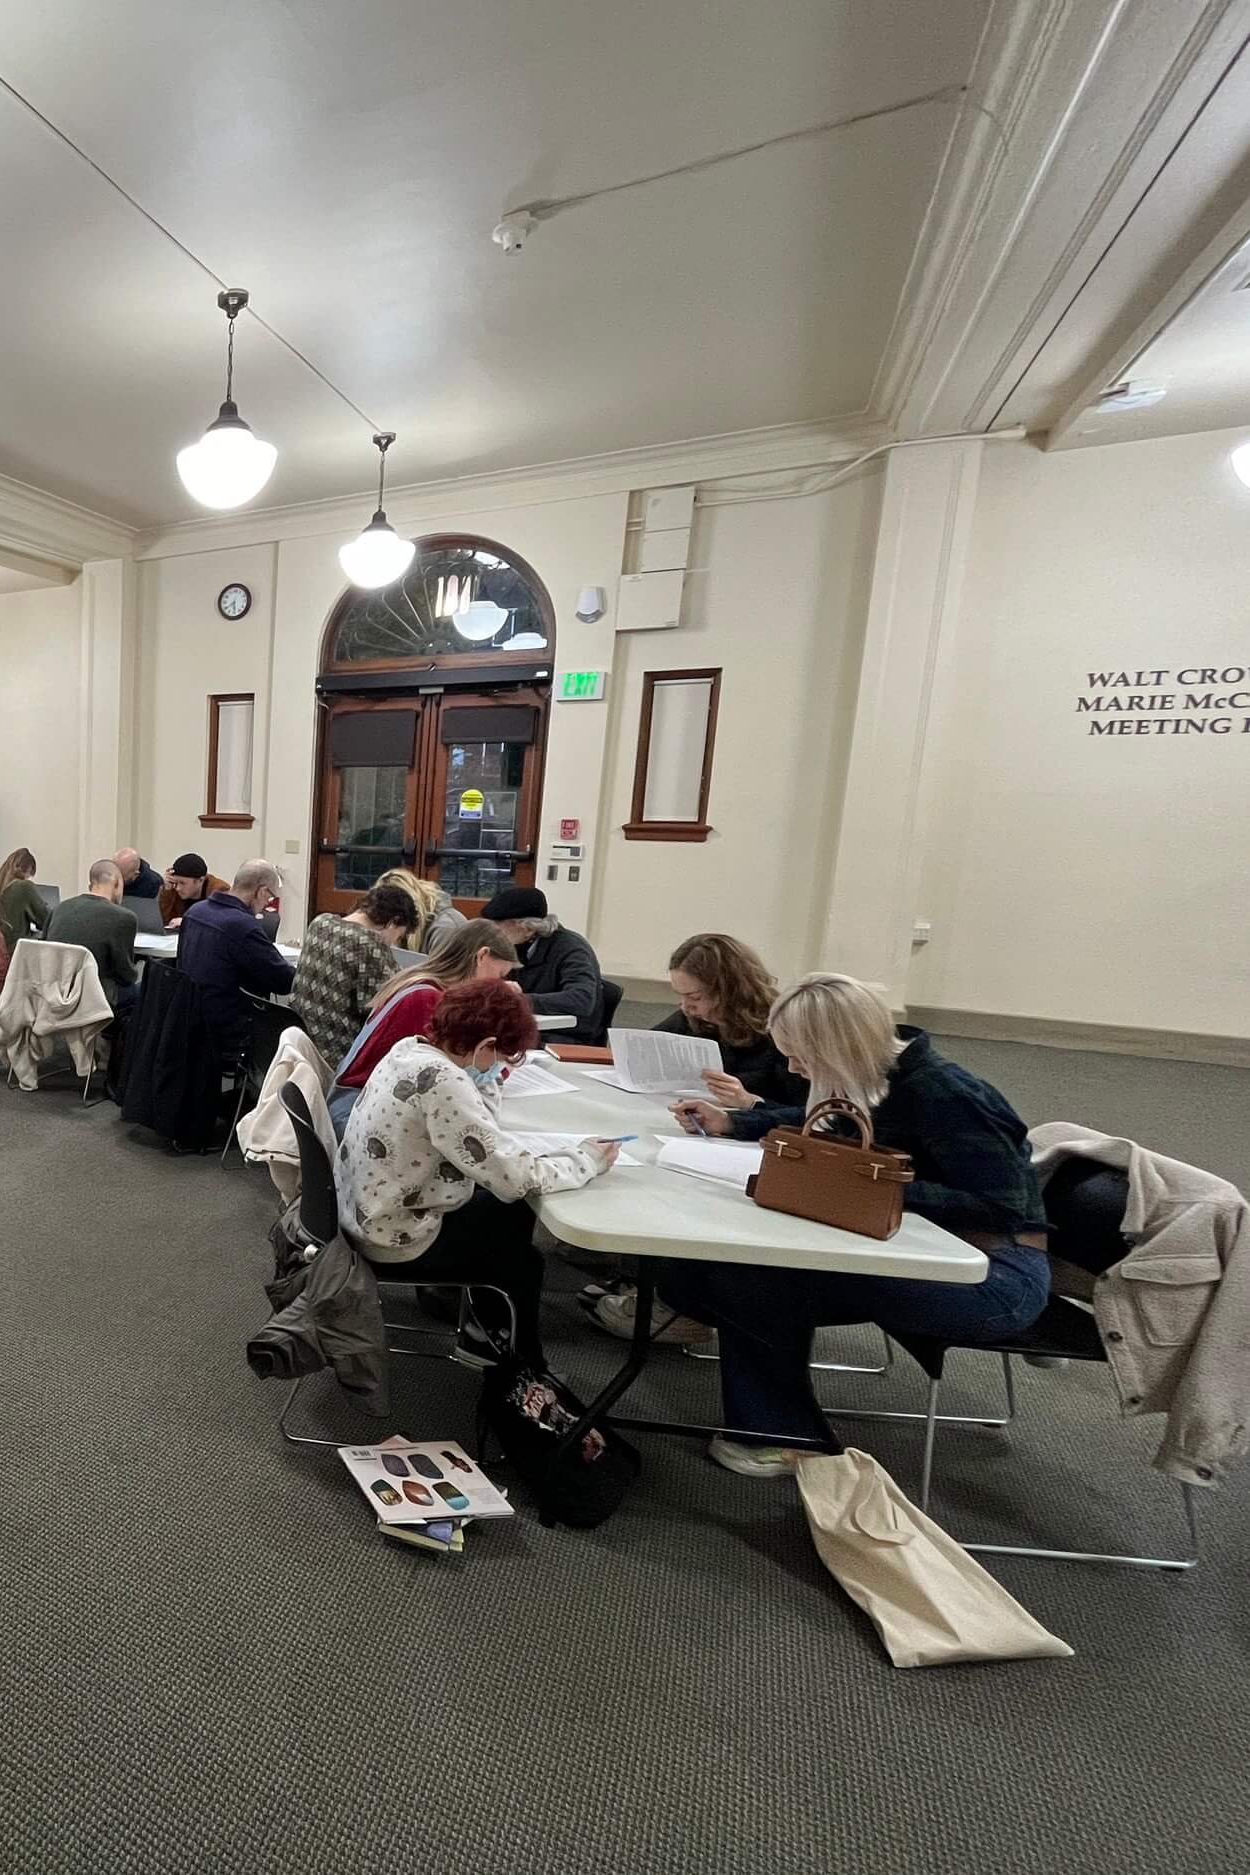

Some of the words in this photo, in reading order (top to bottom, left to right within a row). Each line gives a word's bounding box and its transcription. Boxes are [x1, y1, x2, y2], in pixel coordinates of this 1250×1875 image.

[563, 672, 598, 697] EXIT
[1087, 670, 1169, 688] WALT
[1176, 667, 1250, 685] CRO
[1075, 694, 1176, 712] MARIE
[1087, 717, 1232, 735] MEETING
